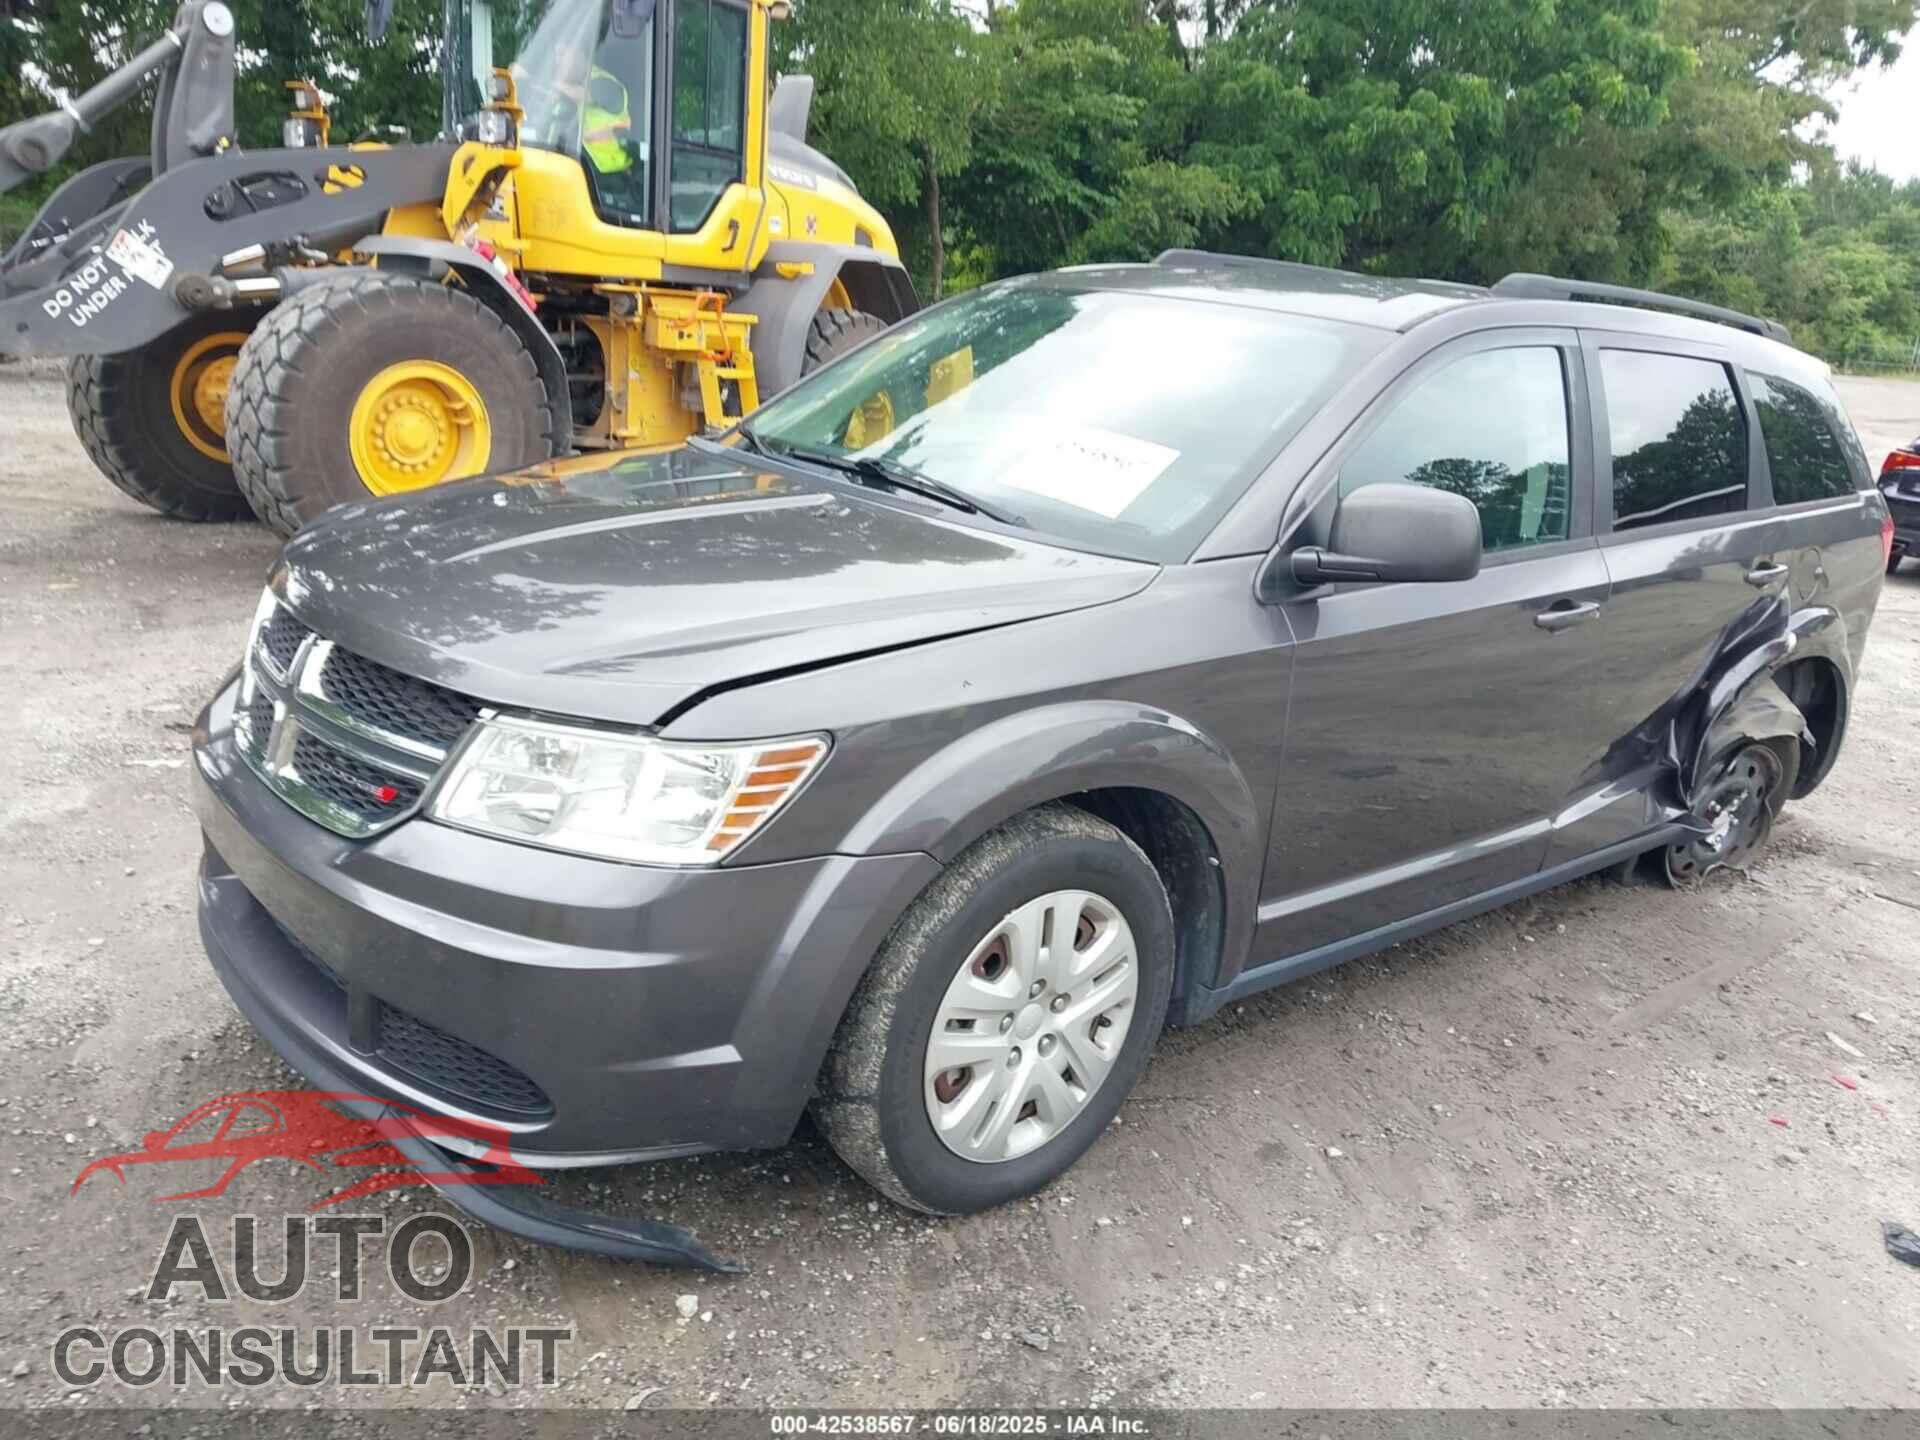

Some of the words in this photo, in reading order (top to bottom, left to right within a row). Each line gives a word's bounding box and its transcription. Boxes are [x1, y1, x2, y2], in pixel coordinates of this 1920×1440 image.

[42, 289, 74, 319] DO
[69, 256, 108, 296] NOT
[68, 275, 127, 328] UNDER
